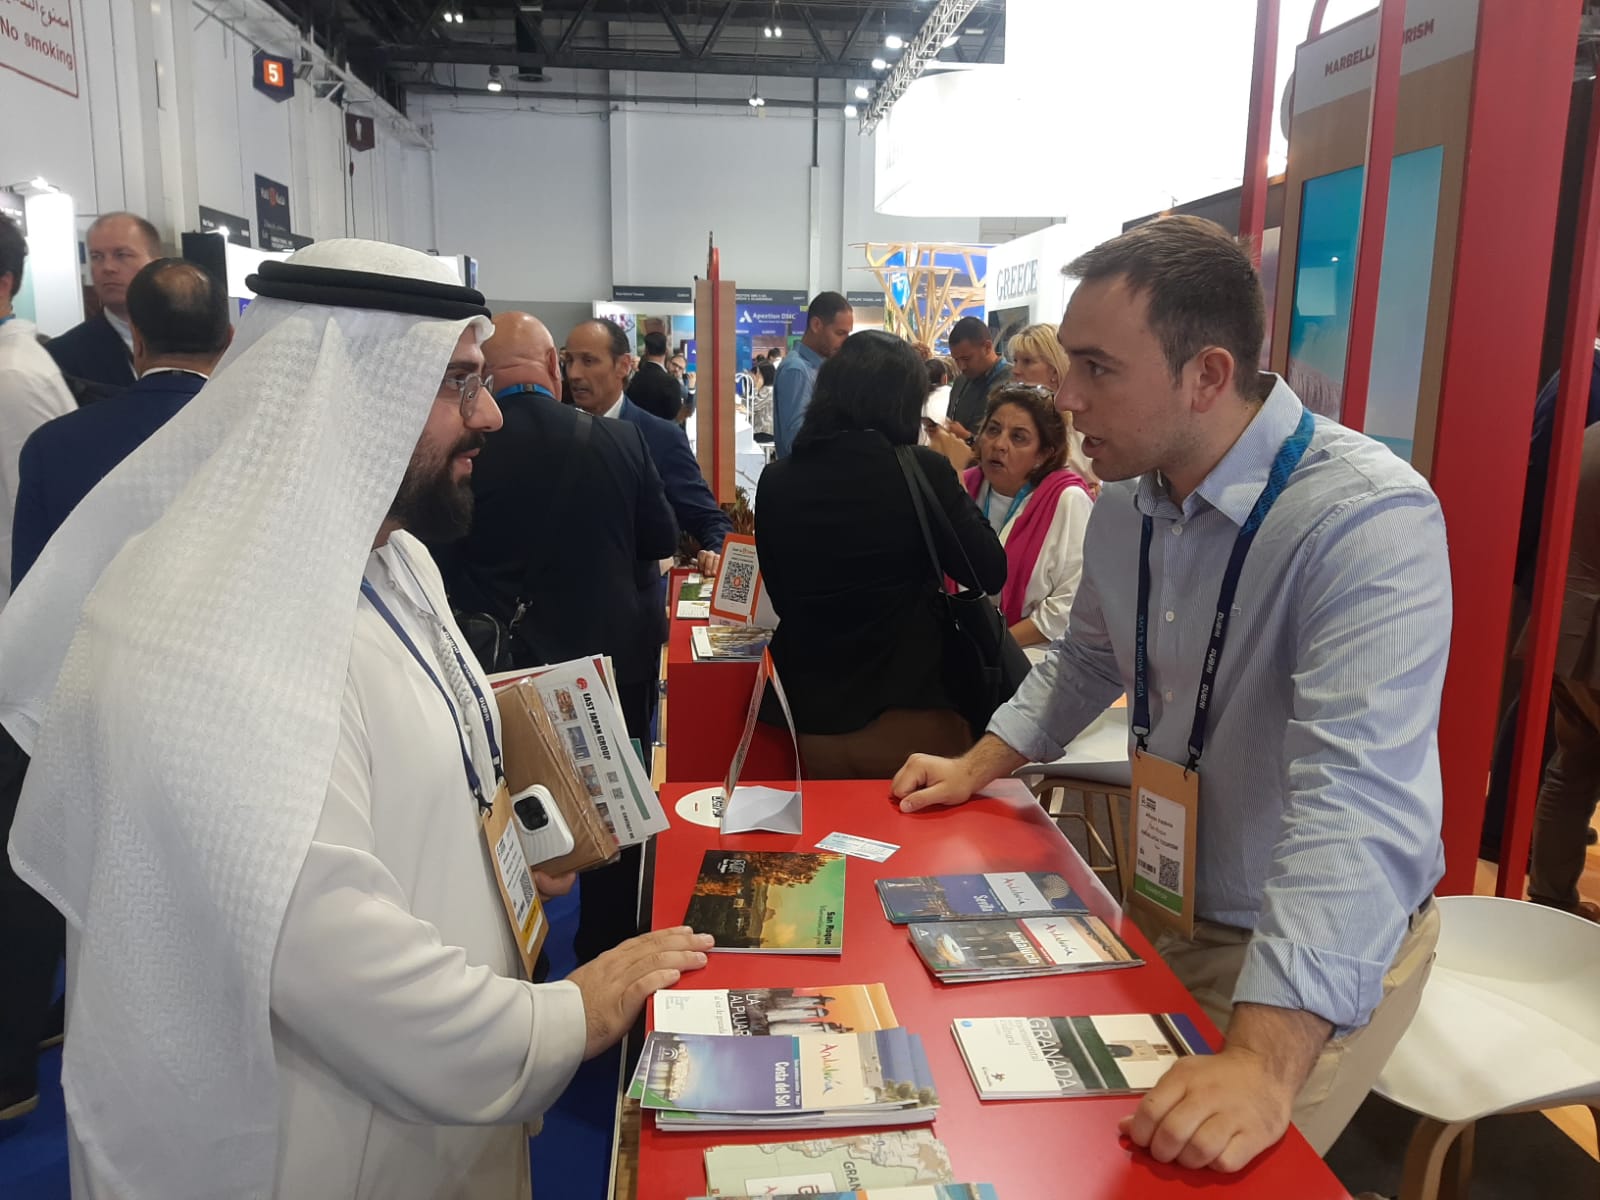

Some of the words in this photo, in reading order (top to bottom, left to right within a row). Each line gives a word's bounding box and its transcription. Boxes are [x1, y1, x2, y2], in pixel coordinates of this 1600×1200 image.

[1402, 18, 1435, 45] RISM
[0, 16, 19, 41] No
[24, 32, 74, 71] smoking
[268, 63, 279, 83] 5
[996, 258, 1039, 301] GREECE
[1136, 645, 1145, 672] WORK
[582, 692, 596, 711] EAST
[588, 710, 603, 733] JAPAN
[596, 731, 612, 761] GROUP
[826, 911, 836, 924] San
[823, 924, 835, 945] Roque
[745, 993, 761, 1006] LA
[1029, 1018, 1078, 1090] GRANADA
[775, 1061, 790, 1082] Costa
[775, 1082, 791, 1094] del
[775, 1094, 791, 1107] Sol
